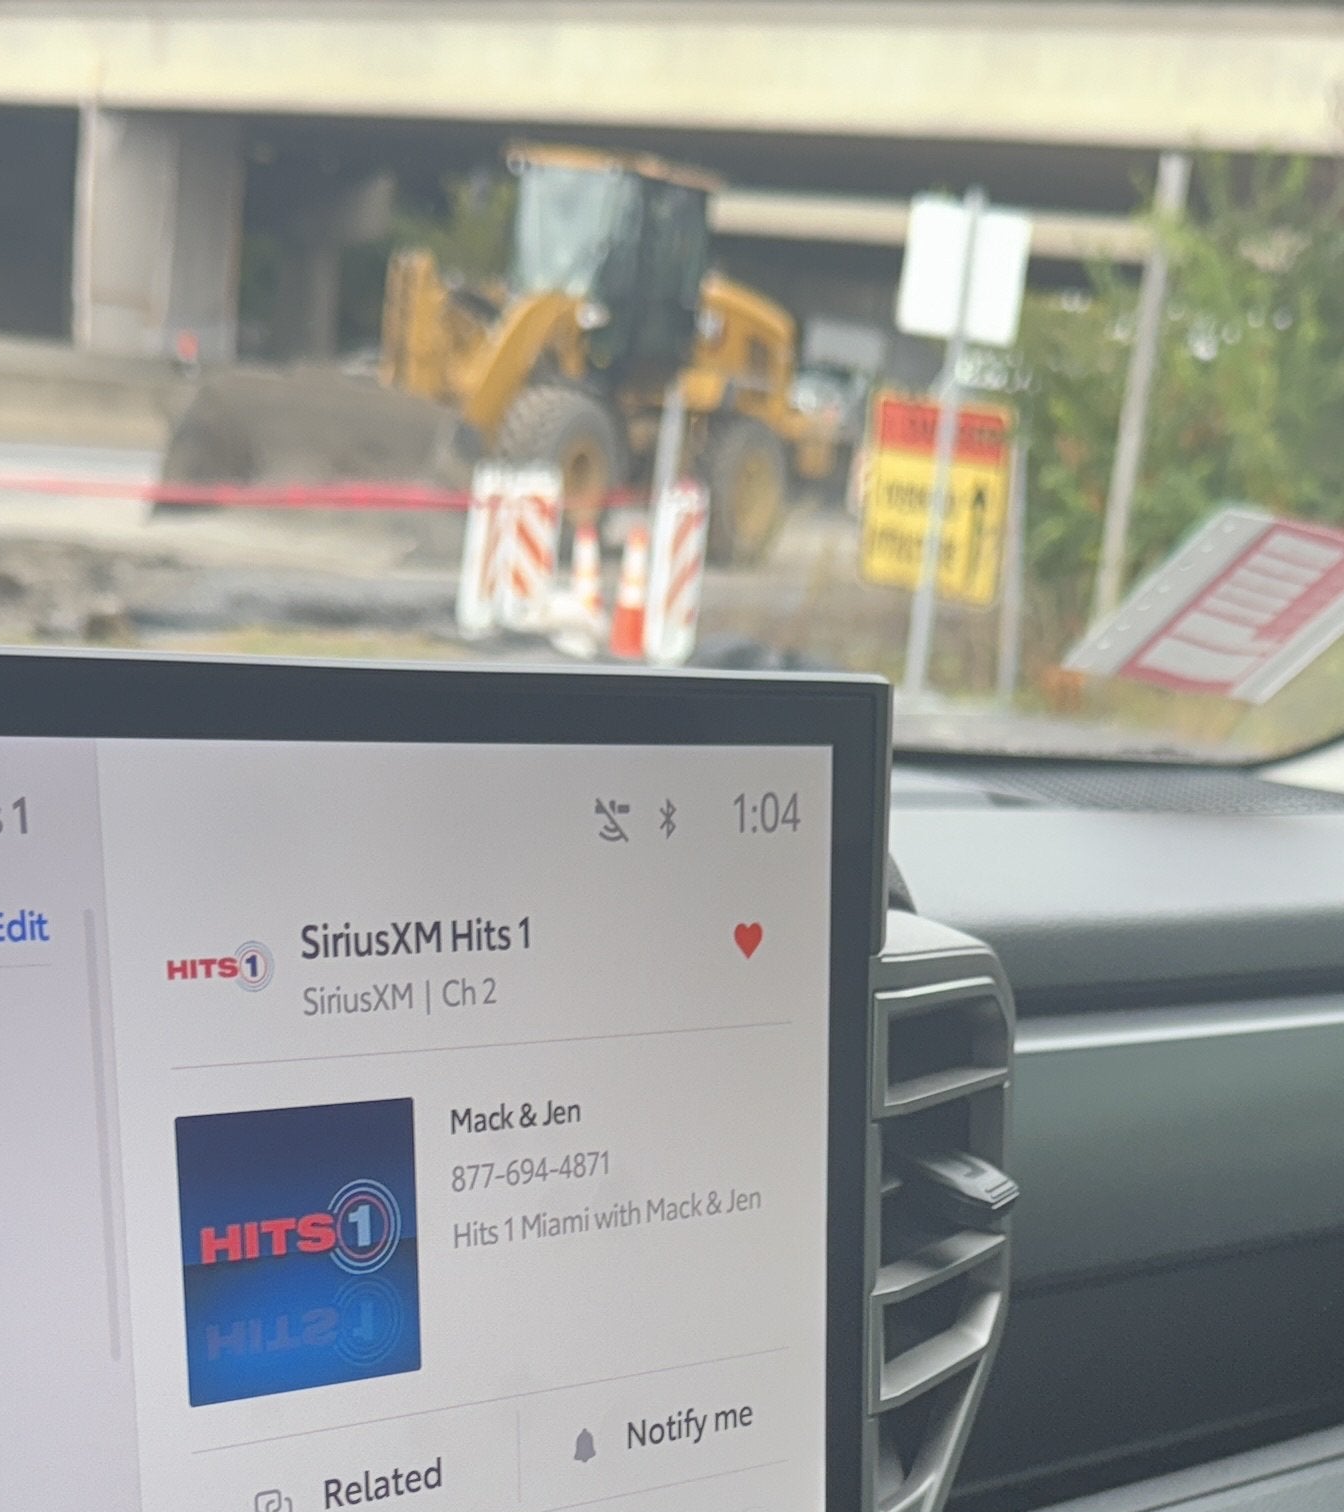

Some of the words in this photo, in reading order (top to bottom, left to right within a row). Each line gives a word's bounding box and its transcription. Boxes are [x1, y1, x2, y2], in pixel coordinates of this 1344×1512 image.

[12, 797, 30, 834] 1
[733, 791, 802, 834] 1:04
[301, 919, 443, 960] SiriusXM
[451, 917, 512, 954] Hits
[517, 916, 533, 949] 1
[166, 956, 240, 981] HITS
[302, 981, 415, 1018] SiriusXM
[442, 977, 477, 1010] Ch
[482, 977, 498, 1006] 2
[450, 1103, 515, 1135] Mack
[520, 1102, 538, 1129] &
[541, 1099, 582, 1129] Jen
[451, 1150, 611, 1194] 877-694-4871
[200, 1212, 337, 1265] HITS
[453, 1217, 499, 1250] Hits
[504, 1215, 515, 1242] 1
[521, 1206, 590, 1240] Miami
[594, 1200, 642, 1233] with
[646, 1195, 703, 1227] Mack
[706, 1192, 723, 1217] &
[725, 1187, 763, 1219] Jen
[626, 1407, 708, 1450] Notify
[714, 1403, 754, 1432] me
[322, 1457, 444, 1510] Related
